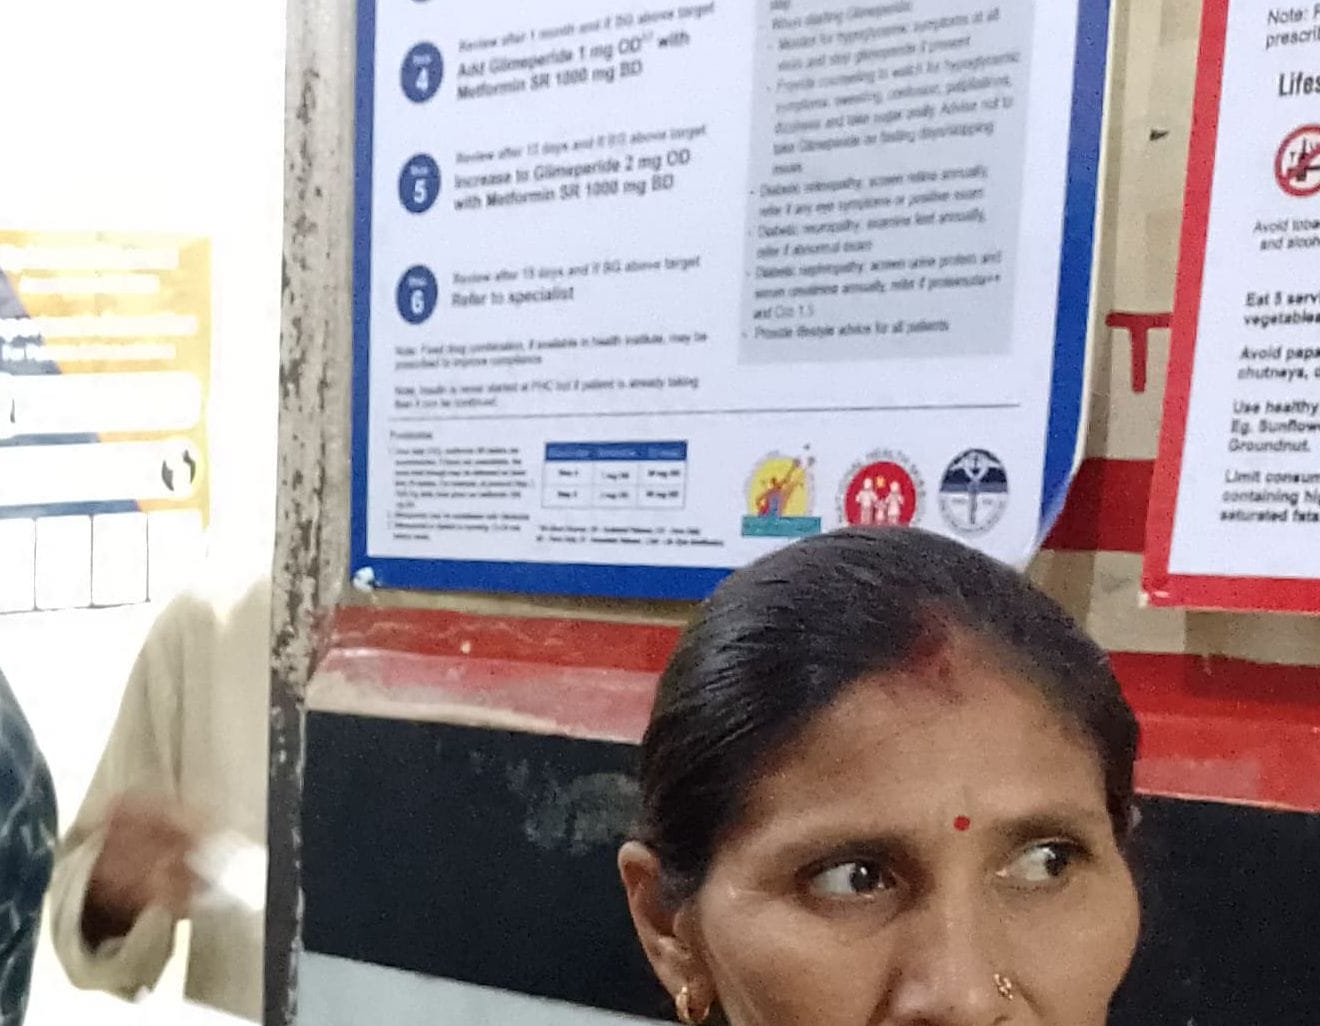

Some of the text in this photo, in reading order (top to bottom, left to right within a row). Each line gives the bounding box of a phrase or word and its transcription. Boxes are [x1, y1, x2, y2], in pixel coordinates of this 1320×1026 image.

[1267, 8, 1308, 25] Note:
[590, 44, 613, 61] mg
[658, 30, 690, 48] with
[414, 66, 430, 93] 4
[457, 79, 525, 99] Metformin
[592, 67, 614, 83] mg
[454, 172, 511, 188] Increase
[638, 155, 661, 171] mg
[667, 148, 690, 166] OD
[413, 178, 426, 203] 5
[454, 195, 480, 210] with
[486, 188, 554, 208] Metformin
[623, 180, 646, 196] mg
[1253, 219, 1288, 232] Avoid
[1260, 237, 1282, 250] and
[411, 289, 425, 314] 6
[451, 292, 485, 307] Refer
[508, 286, 573, 306] specialist
[1246, 291, 1269, 307] Eat
[1240, 345, 1282, 360] Avoid
[1233, 400, 1319, 416] Use healthy
[1225, 469, 1260, 483] Limit
[1223, 489, 1298, 506] containing
[1220, 508, 1287, 522] saturated
